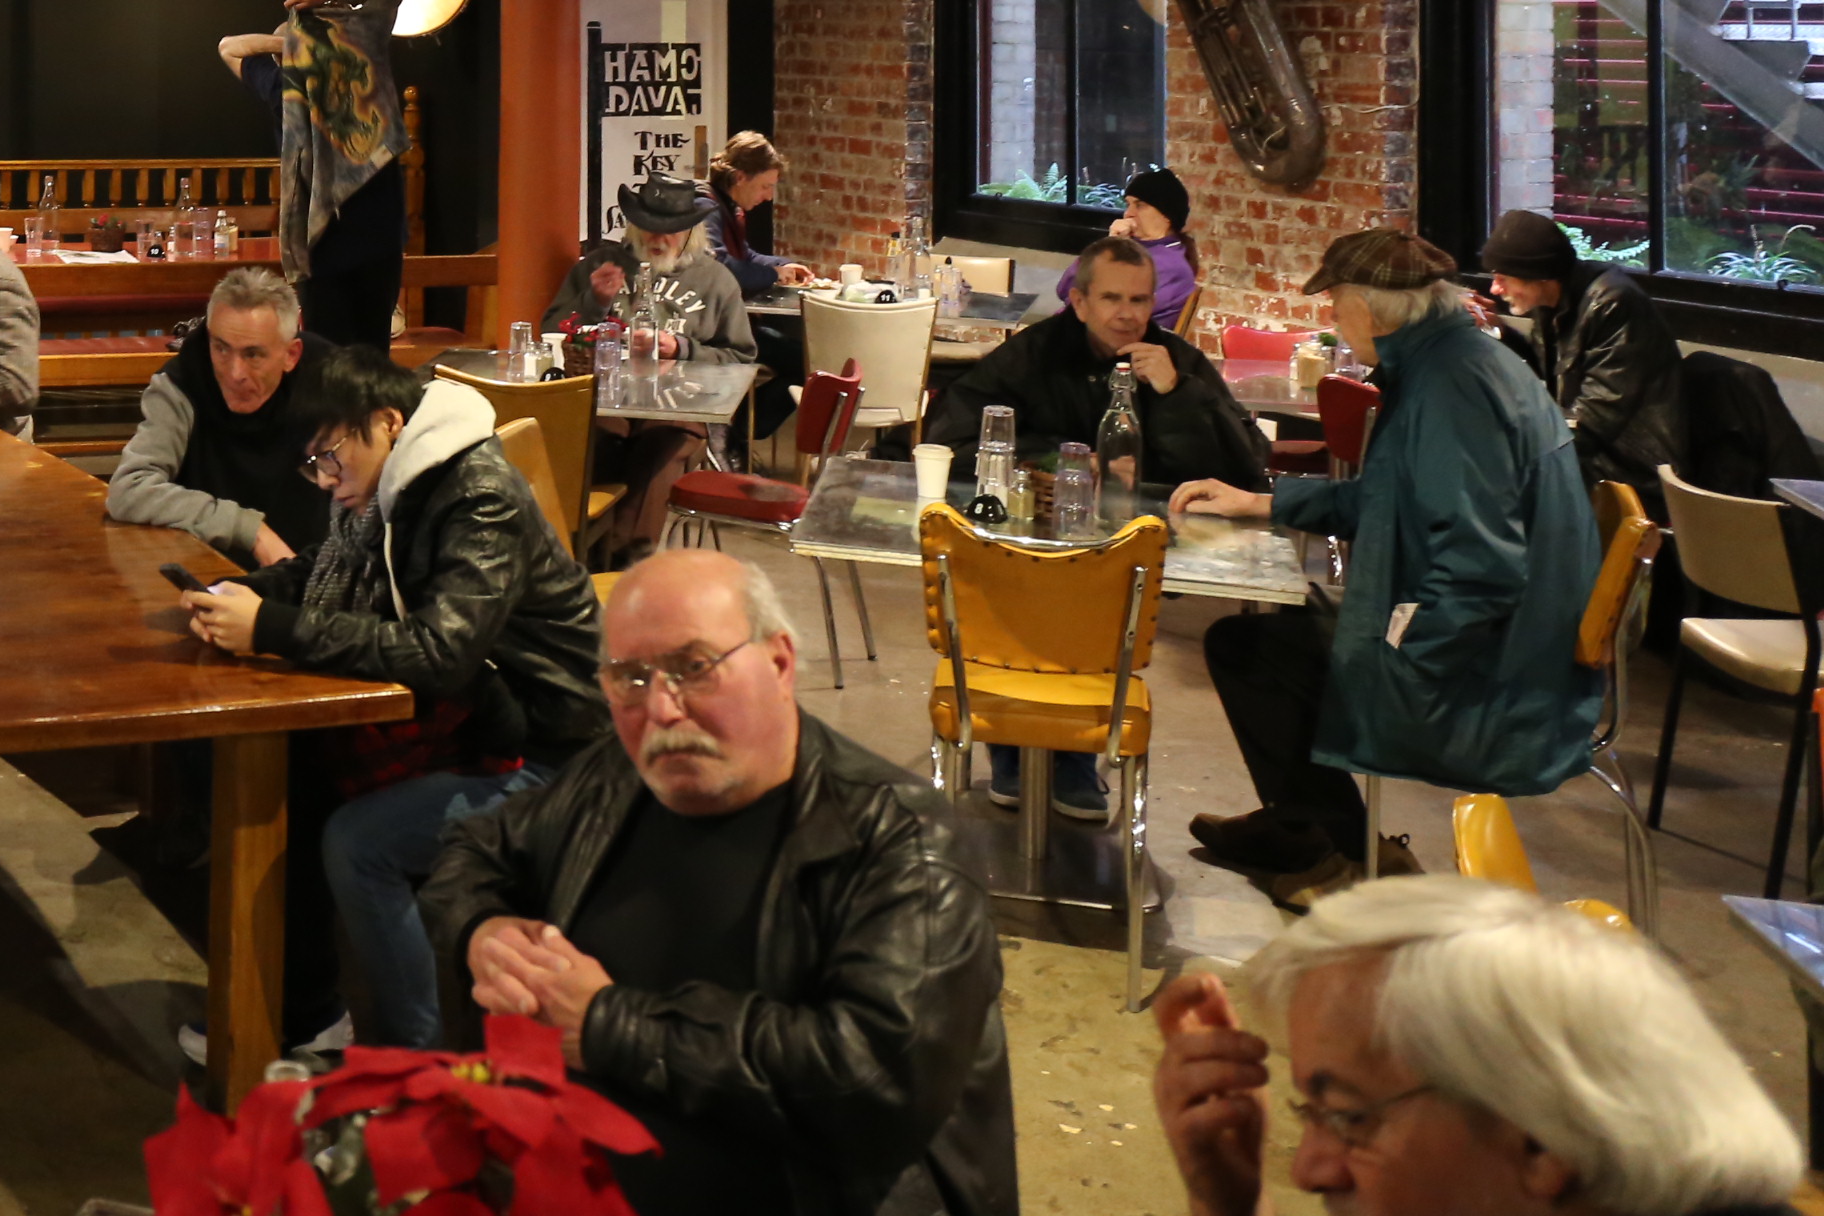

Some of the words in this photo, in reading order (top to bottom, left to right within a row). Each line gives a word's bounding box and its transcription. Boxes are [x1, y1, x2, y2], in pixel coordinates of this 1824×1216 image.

[604, 47, 701, 83] HAMO
[604, 85, 688, 116] DAVA
[634, 130, 691, 150] THE
[632, 150, 681, 176] KEY
[880, 294, 891, 302] 11
[974, 503, 984, 515] 8
